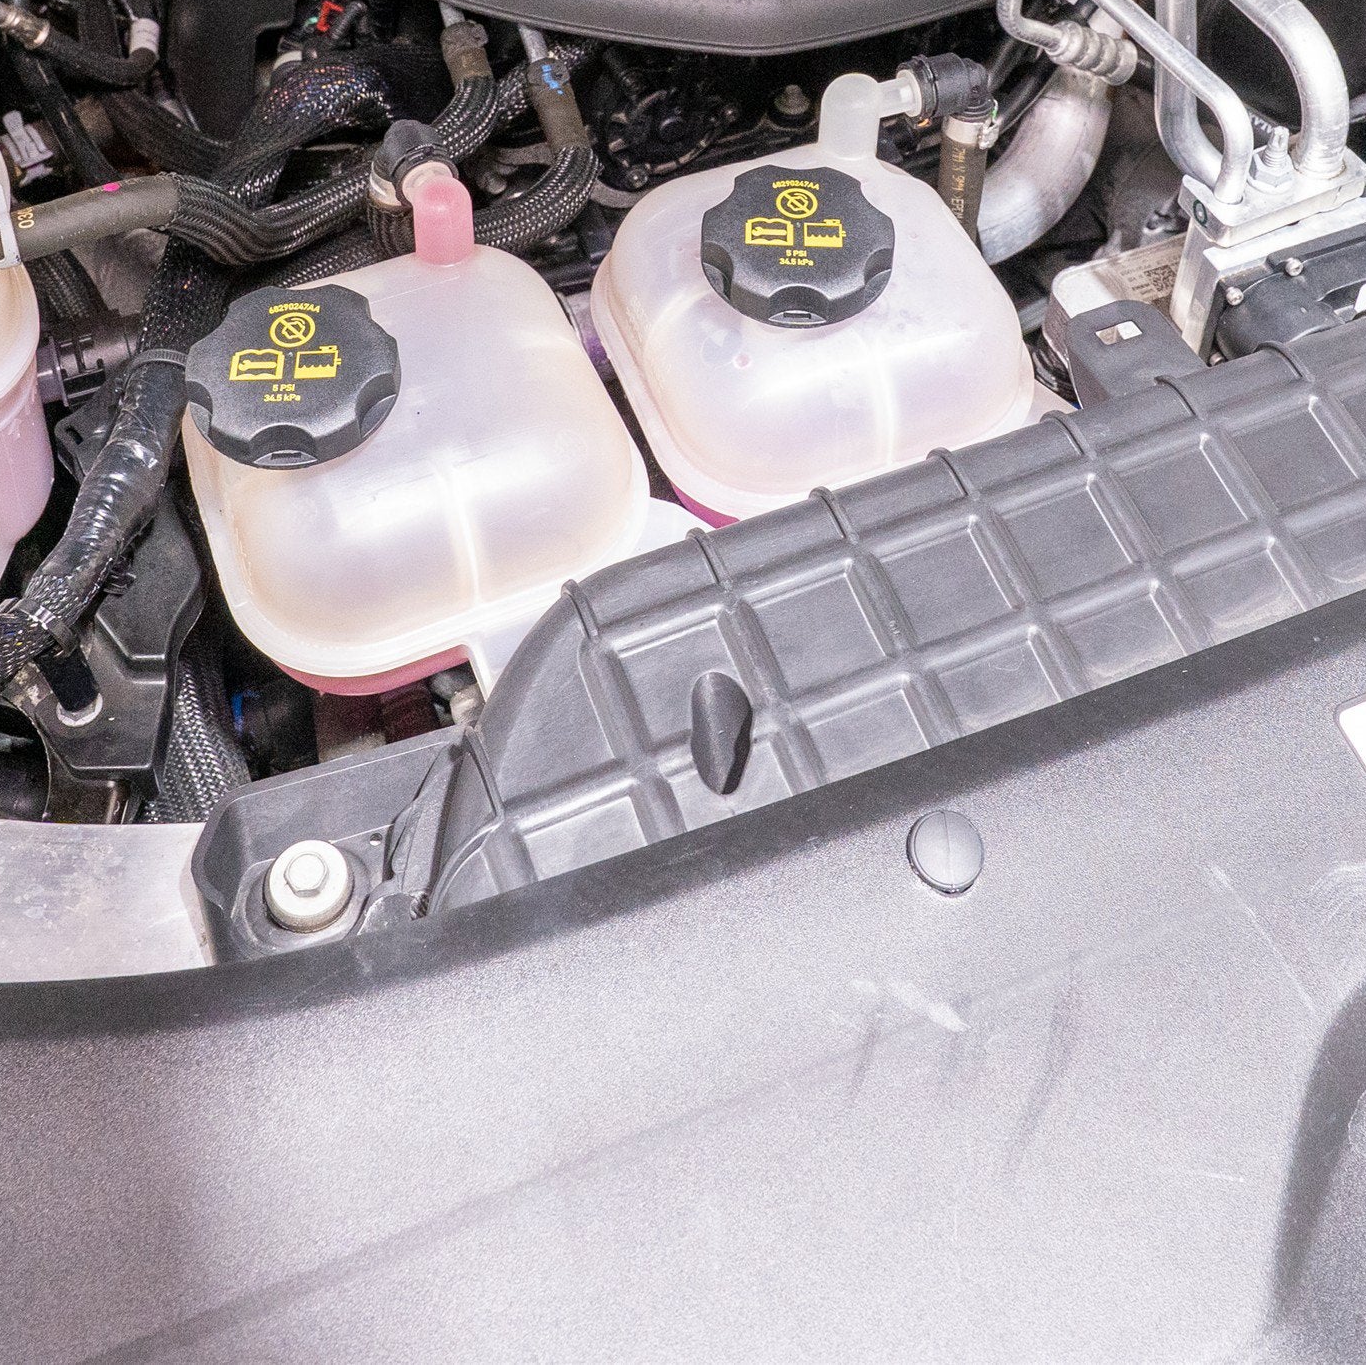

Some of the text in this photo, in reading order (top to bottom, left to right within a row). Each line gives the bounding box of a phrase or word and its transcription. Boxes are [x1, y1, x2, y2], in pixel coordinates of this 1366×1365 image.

[786, 249, 807, 257] 5 PSI
[779, 257, 814, 266] 34.5 kPa
[268, 302, 321, 315] 68290247AA
[280, 383, 295, 392] PSI
[263, 393, 301, 402] 34.5 kPa
